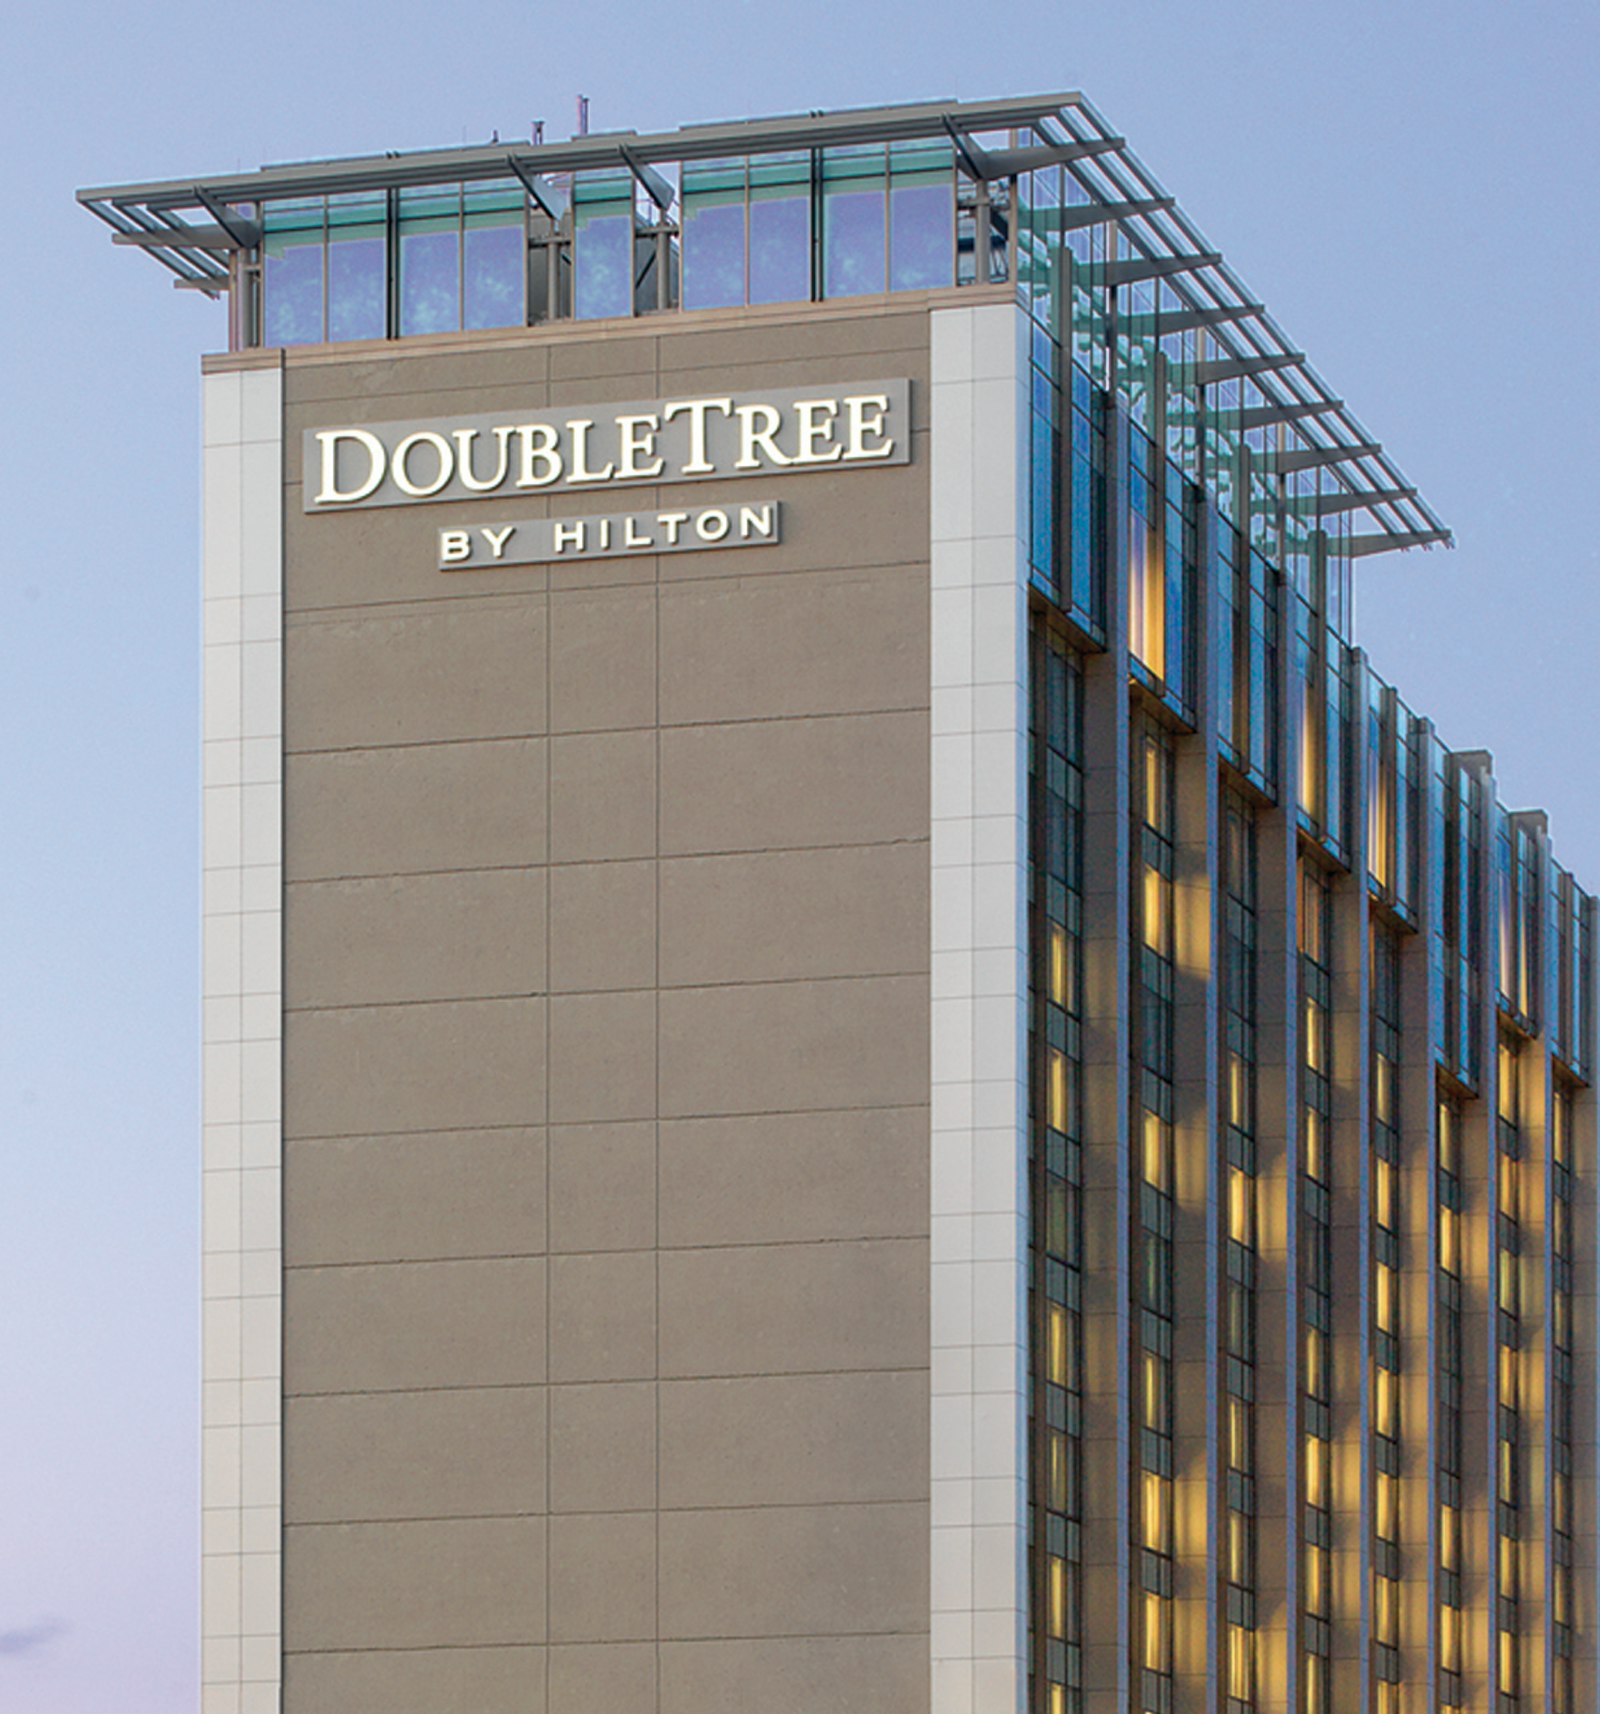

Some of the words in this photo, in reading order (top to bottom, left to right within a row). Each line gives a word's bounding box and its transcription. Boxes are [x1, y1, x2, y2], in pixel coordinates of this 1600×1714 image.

[314, 395, 894, 504] DOUBLETREE
[440, 525, 516, 562] BY
[553, 505, 772, 553] HILTON
